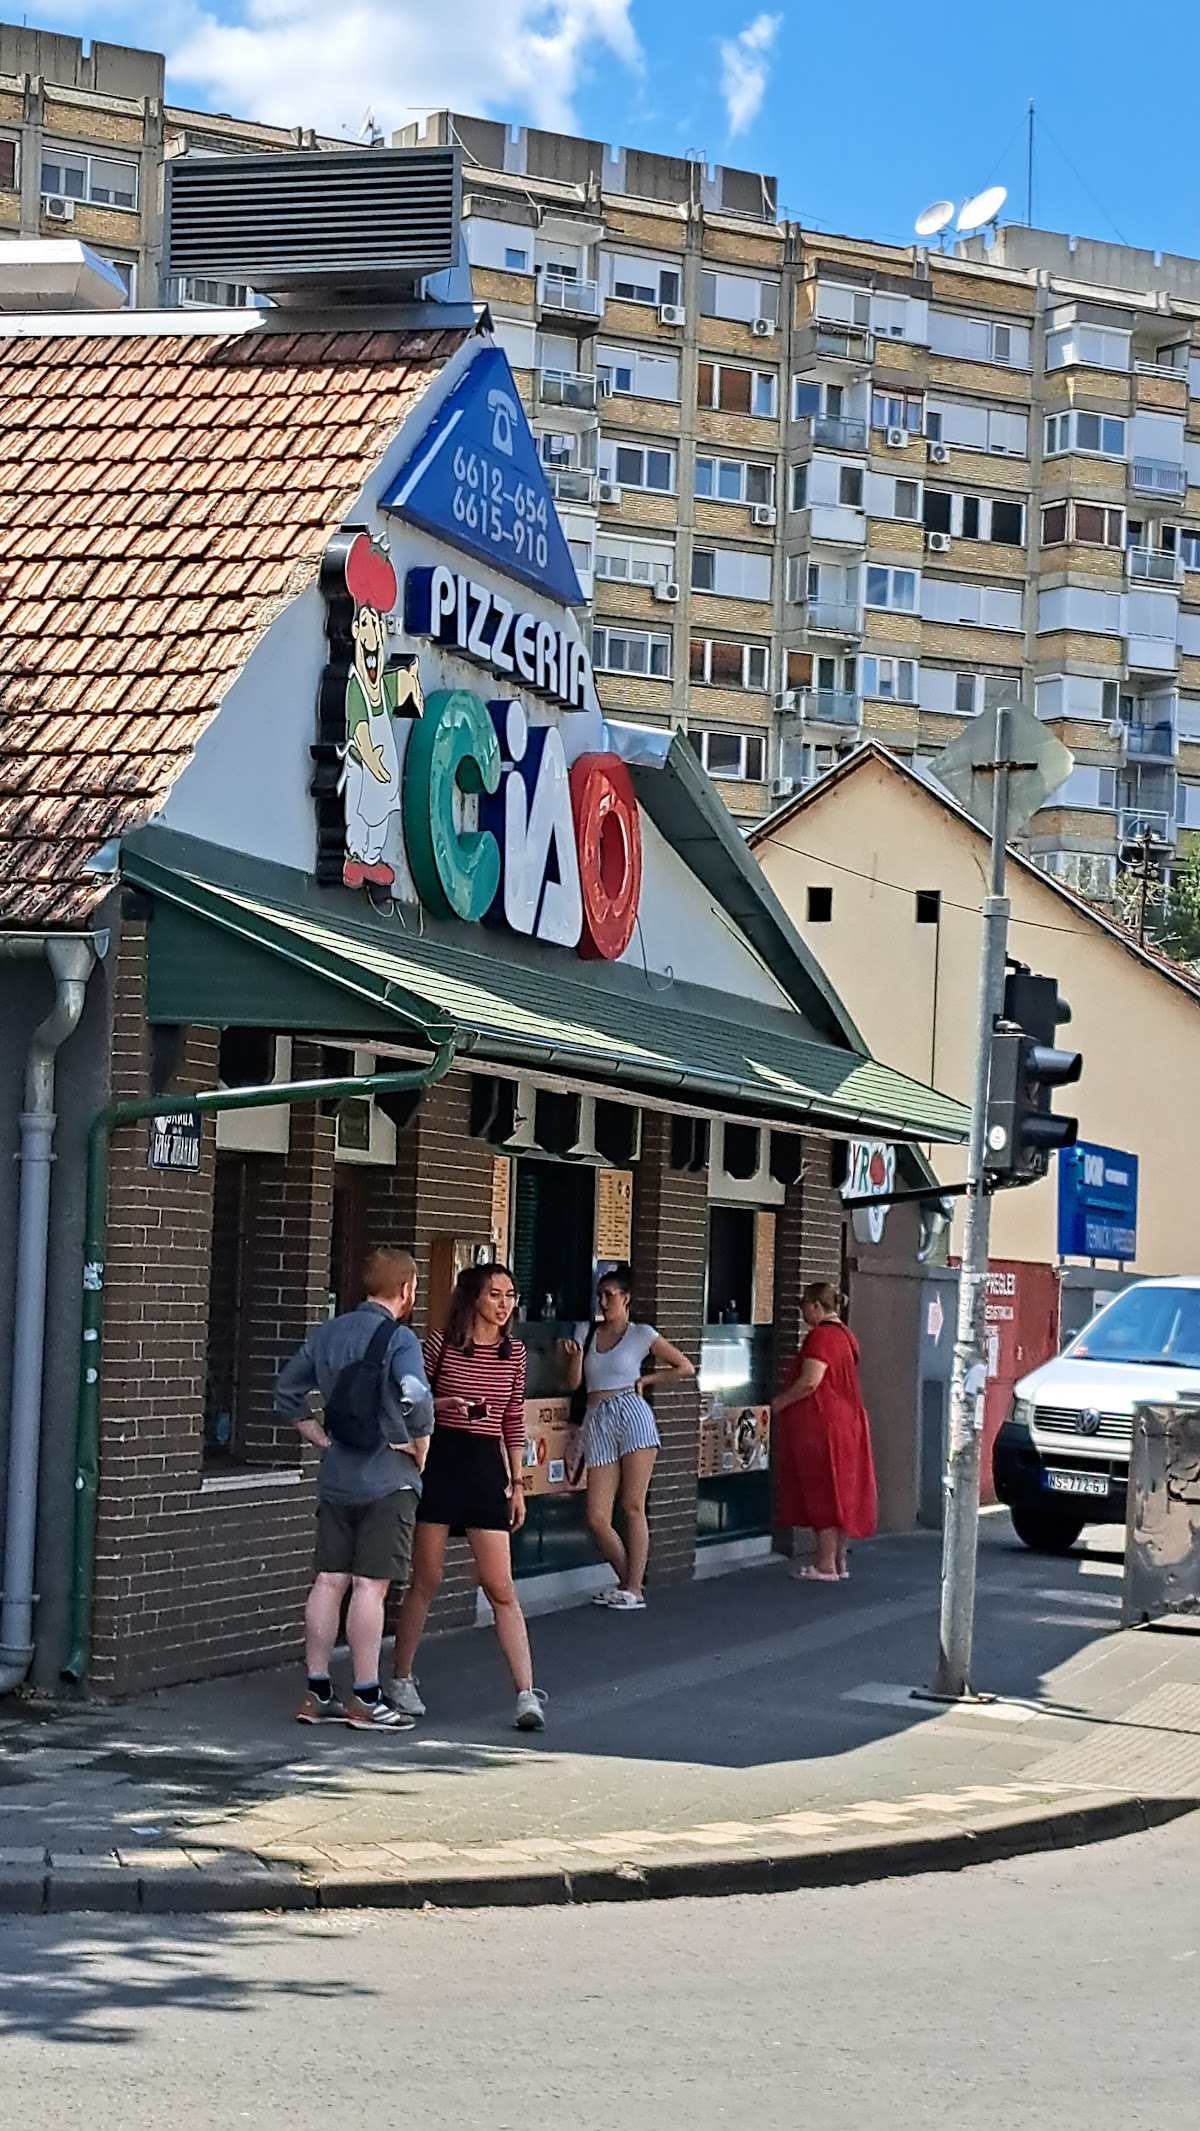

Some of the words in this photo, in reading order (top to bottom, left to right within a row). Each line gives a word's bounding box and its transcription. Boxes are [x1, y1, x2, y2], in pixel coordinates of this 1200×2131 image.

[452, 485, 549, 569] 6615-910
[453, 445, 549, 532] 6612-654
[429, 564, 594, 709] PIZZERIA
